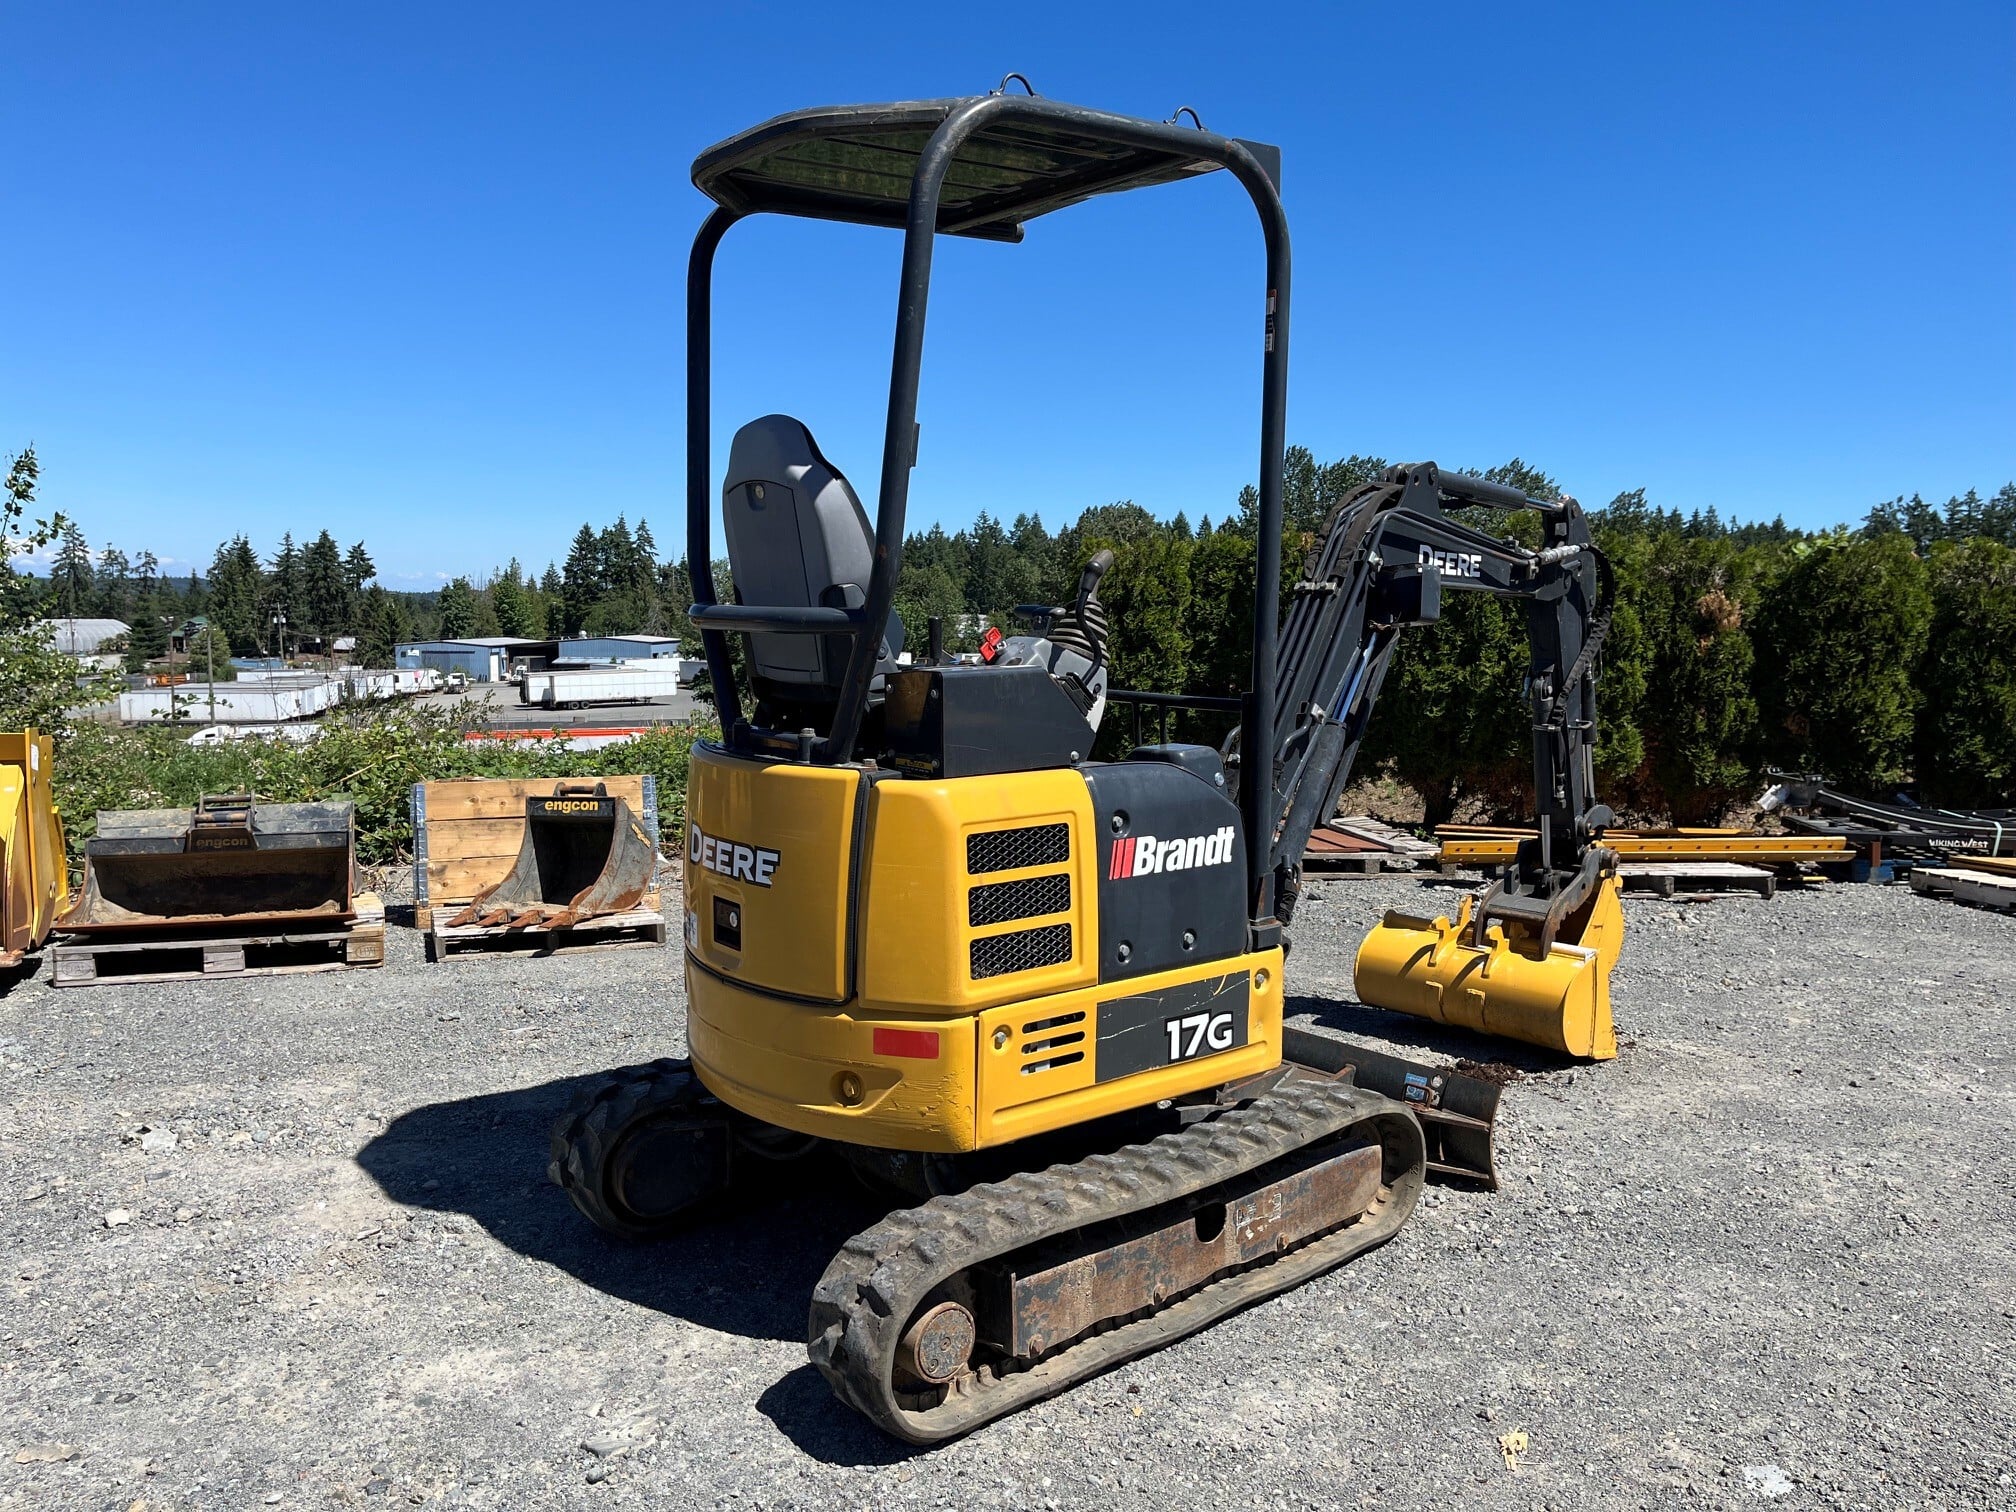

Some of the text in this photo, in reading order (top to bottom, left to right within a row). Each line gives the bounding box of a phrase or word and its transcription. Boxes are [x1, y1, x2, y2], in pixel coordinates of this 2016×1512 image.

[1418, 544, 1482, 578] DEERE
[544, 800, 599, 814] engcon
[196, 838, 248, 849] engcon
[690, 823, 779, 885] DEERE
[1132, 825, 1235, 877] Brandt
[1961, 837, 1989, 849] WEST
[1166, 1012, 1233, 1060] 17G
